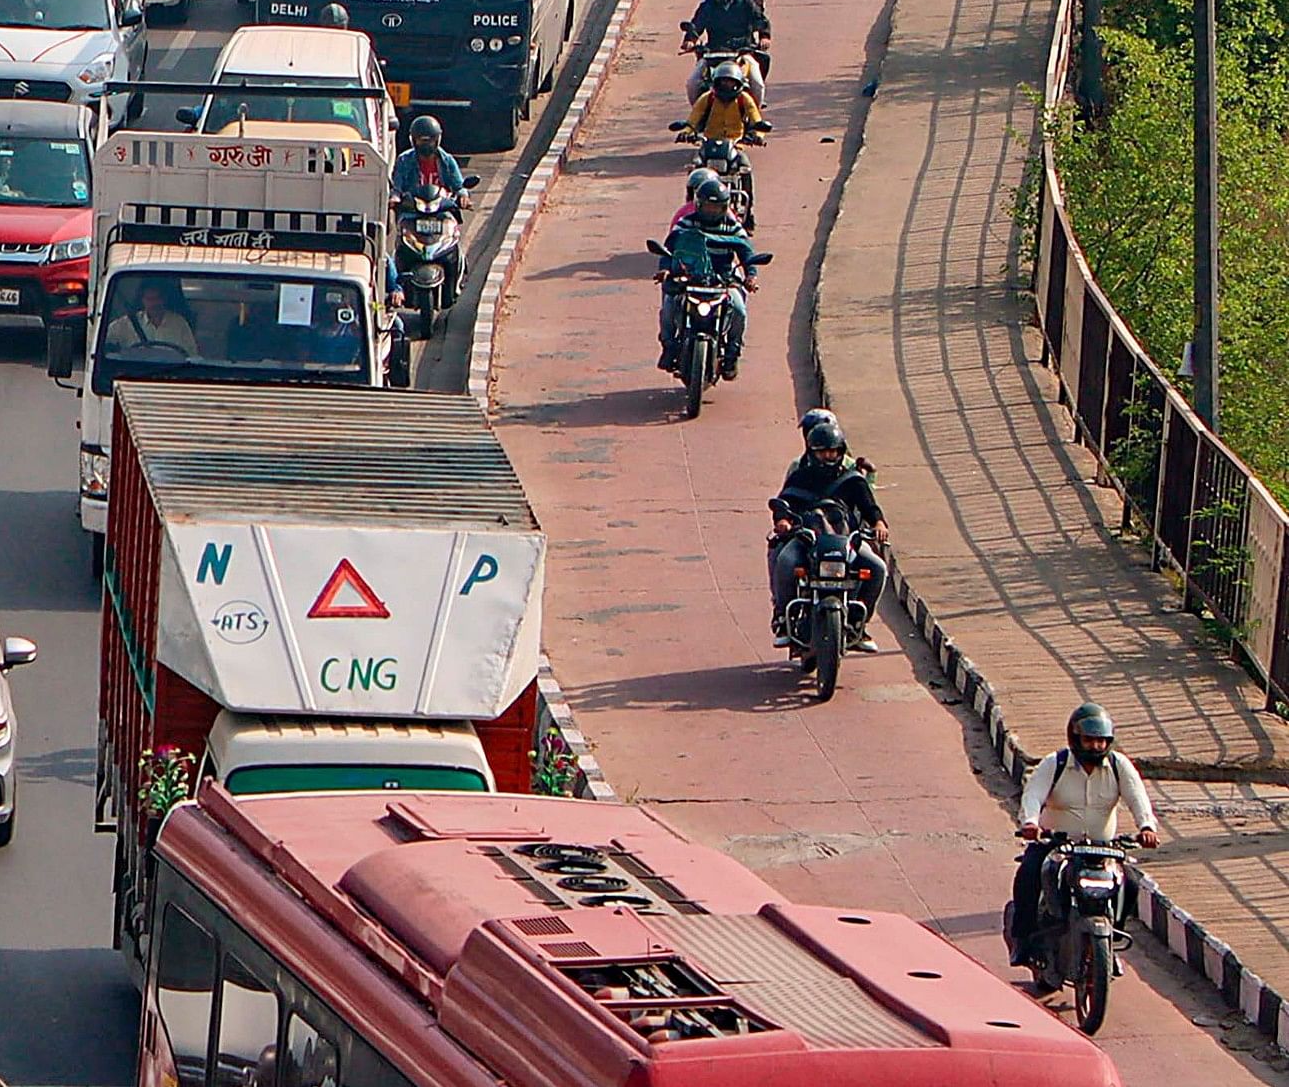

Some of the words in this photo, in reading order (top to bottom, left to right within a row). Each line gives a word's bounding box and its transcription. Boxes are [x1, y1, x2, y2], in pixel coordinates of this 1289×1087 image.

[270, 3, 308, 18] DELHI
[473, 14, 519, 27] POLICE
[246, 145, 273, 167] जी
[196, 542, 233, 584] N
[458, 554, 499, 595] P
[219, 611, 259, 632] ATS
